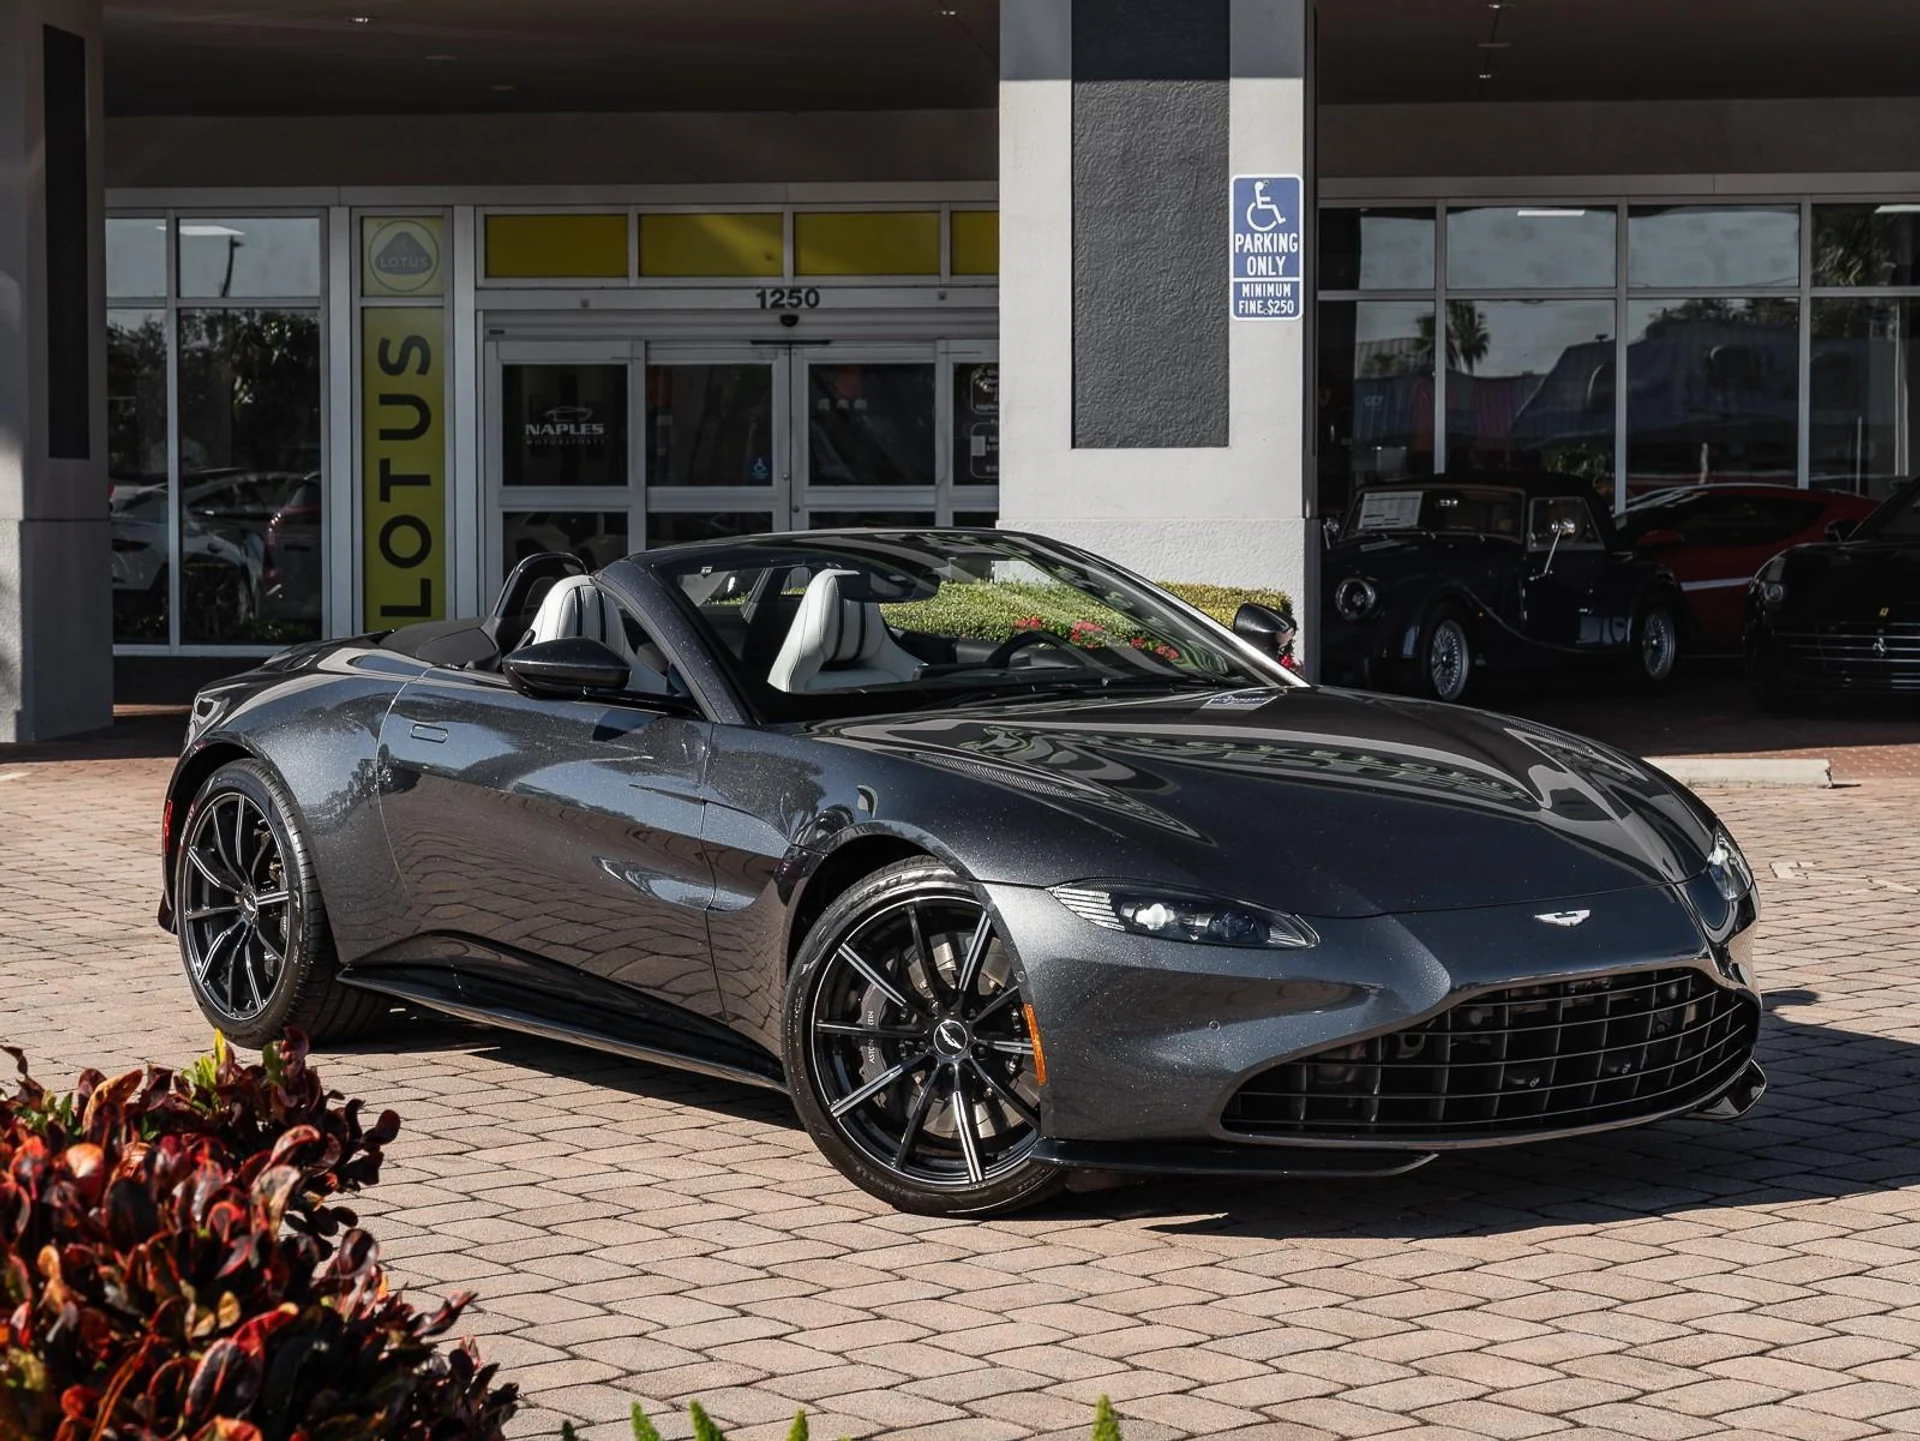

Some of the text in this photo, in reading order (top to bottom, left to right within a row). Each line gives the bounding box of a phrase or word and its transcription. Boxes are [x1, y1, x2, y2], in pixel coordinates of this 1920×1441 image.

[1235, 233, 1299, 253] PARKING
[380, 256, 430, 268] LOTUS
[1246, 256, 1286, 276] ONLY
[756, 287, 820, 309] 1250
[1242, 283, 1291, 298] MINIMUM
[1238, 299, 1295, 316] FINE $250
[525, 423, 605, 435] NAPLES
[378, 334, 432, 618] LOTUS
